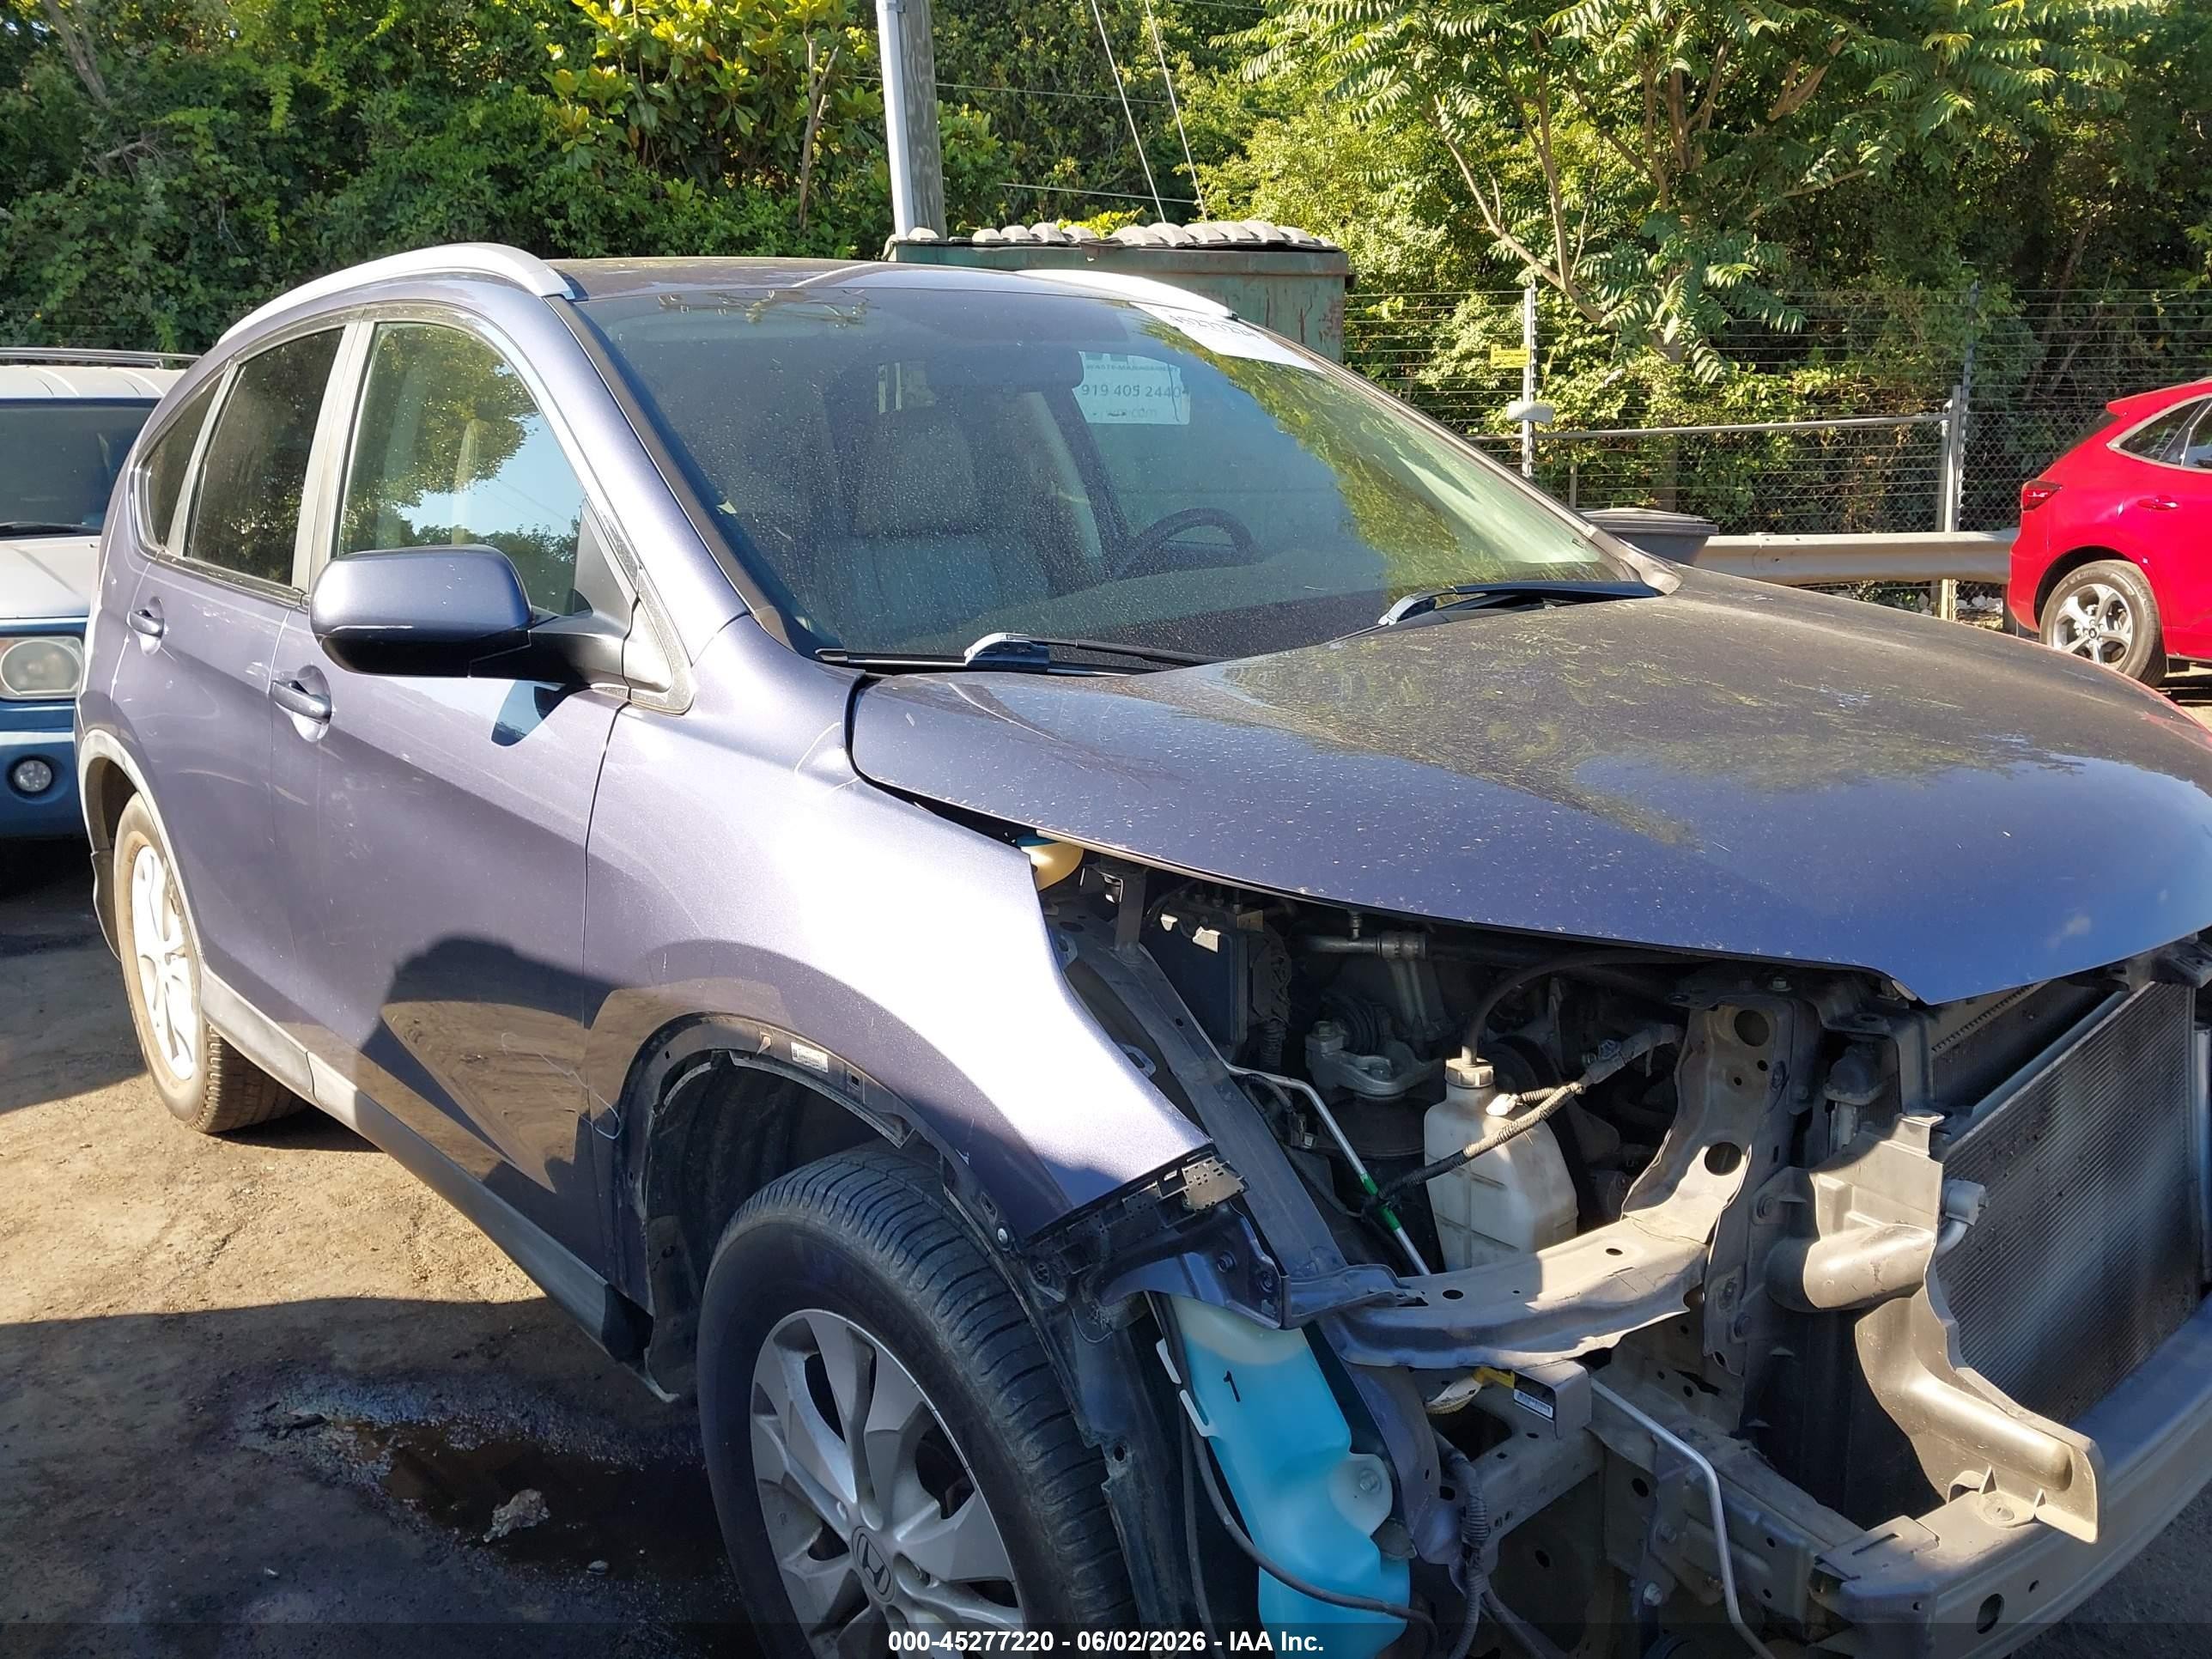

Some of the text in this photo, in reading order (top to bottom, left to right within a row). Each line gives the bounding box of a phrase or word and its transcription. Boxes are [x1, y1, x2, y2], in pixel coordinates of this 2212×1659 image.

[1081, 384, 1109, 397] 919
[1114, 384, 1140, 398] 405
[1223, 1370, 1241, 1402] 1
